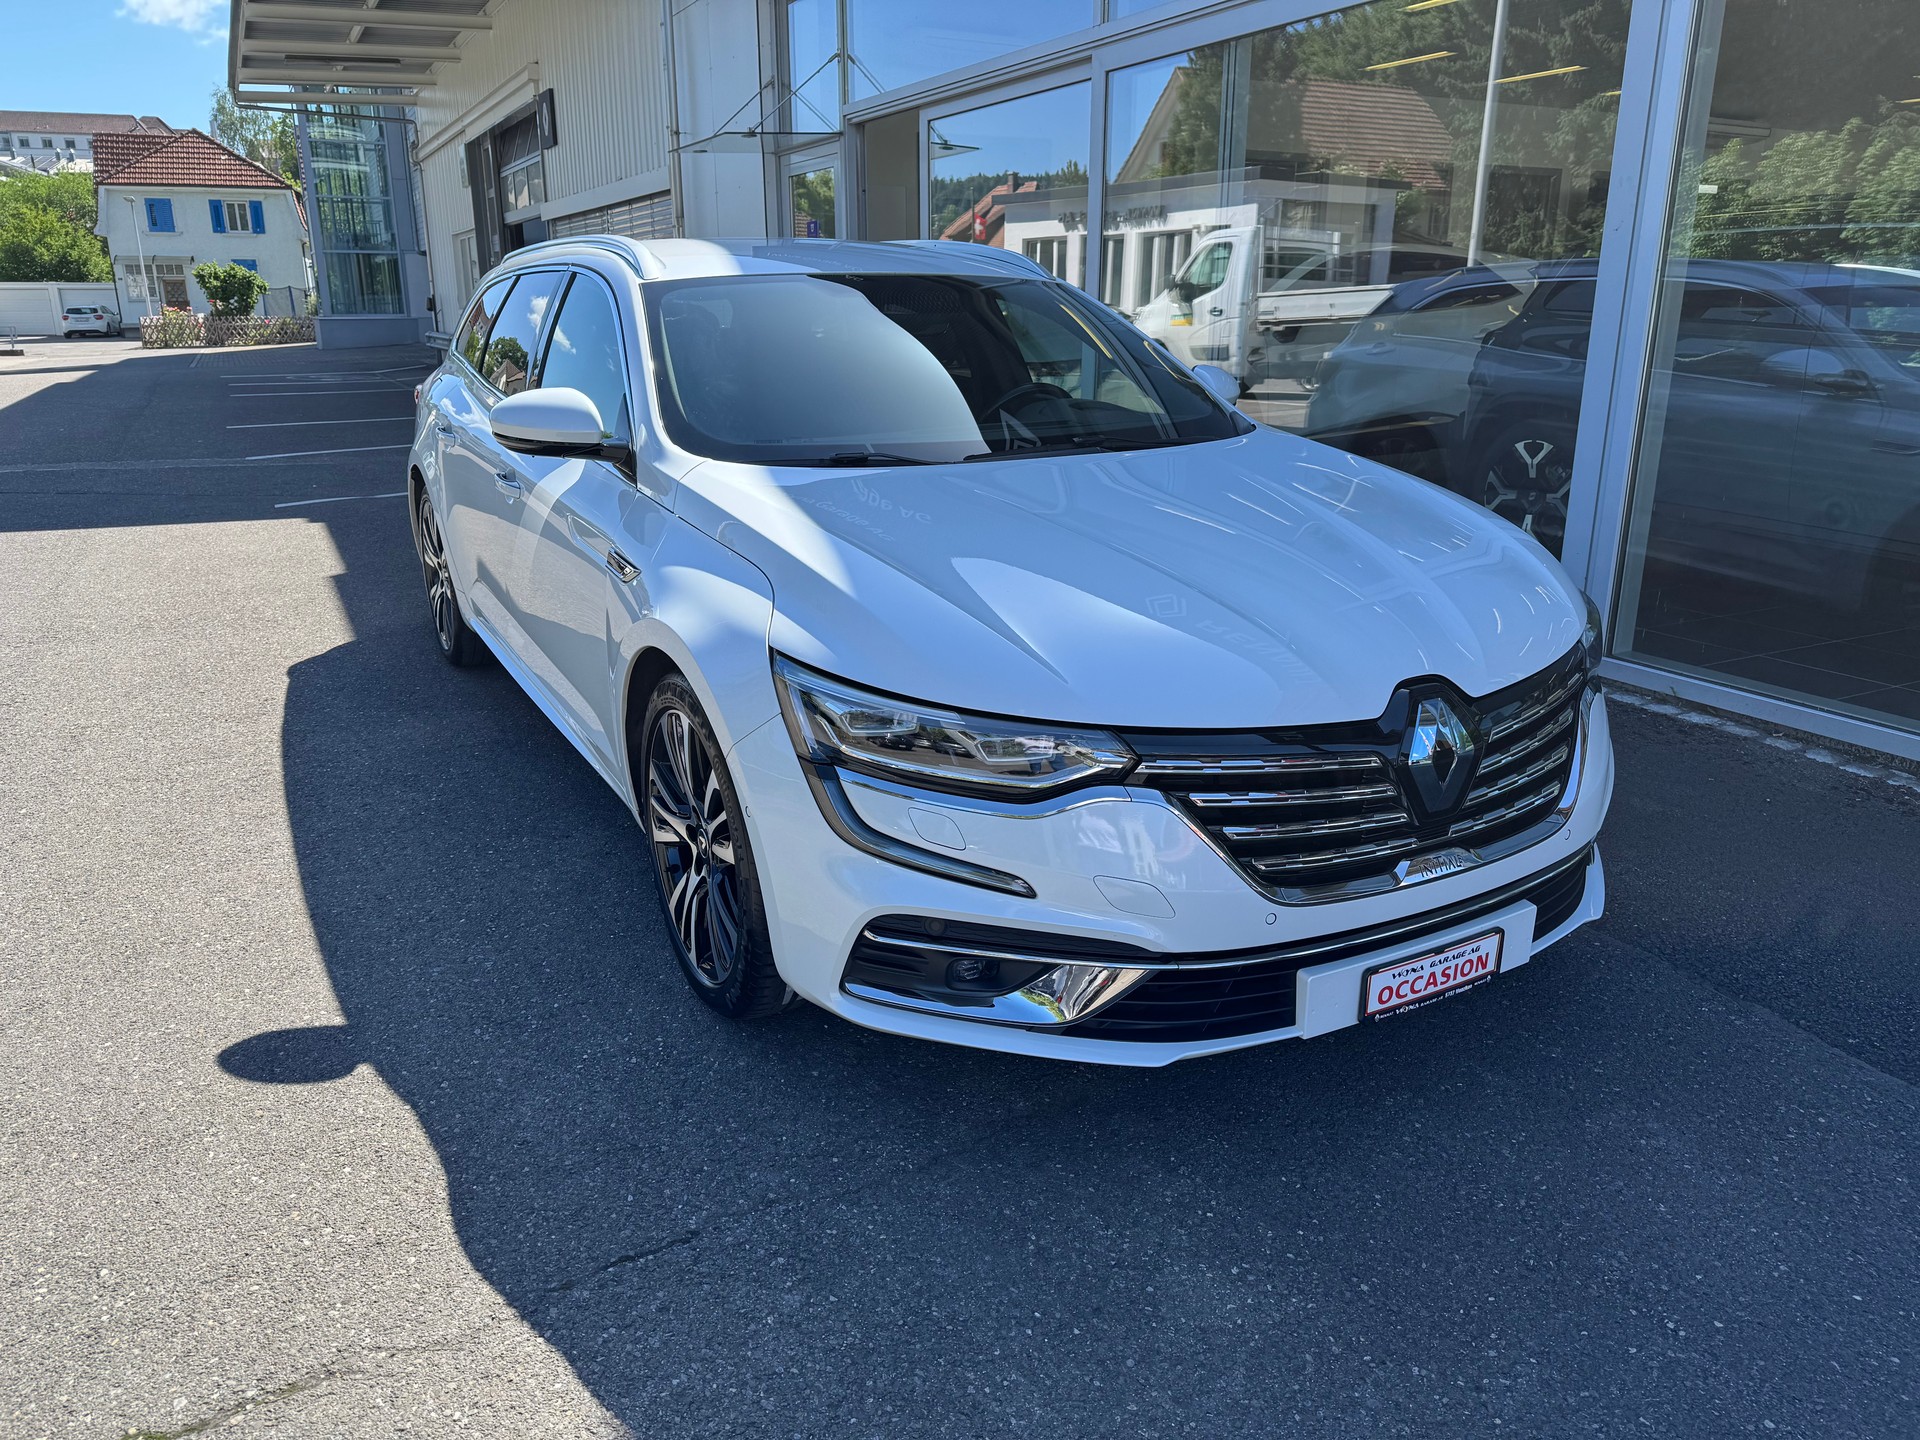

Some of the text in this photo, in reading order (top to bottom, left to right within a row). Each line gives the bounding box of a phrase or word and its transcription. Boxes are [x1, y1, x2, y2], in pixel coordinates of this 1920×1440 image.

[1429, 951, 1467, 968] GARAGE
[1467, 944, 1482, 956] AG
[1377, 952, 1490, 1005] OCCASION
